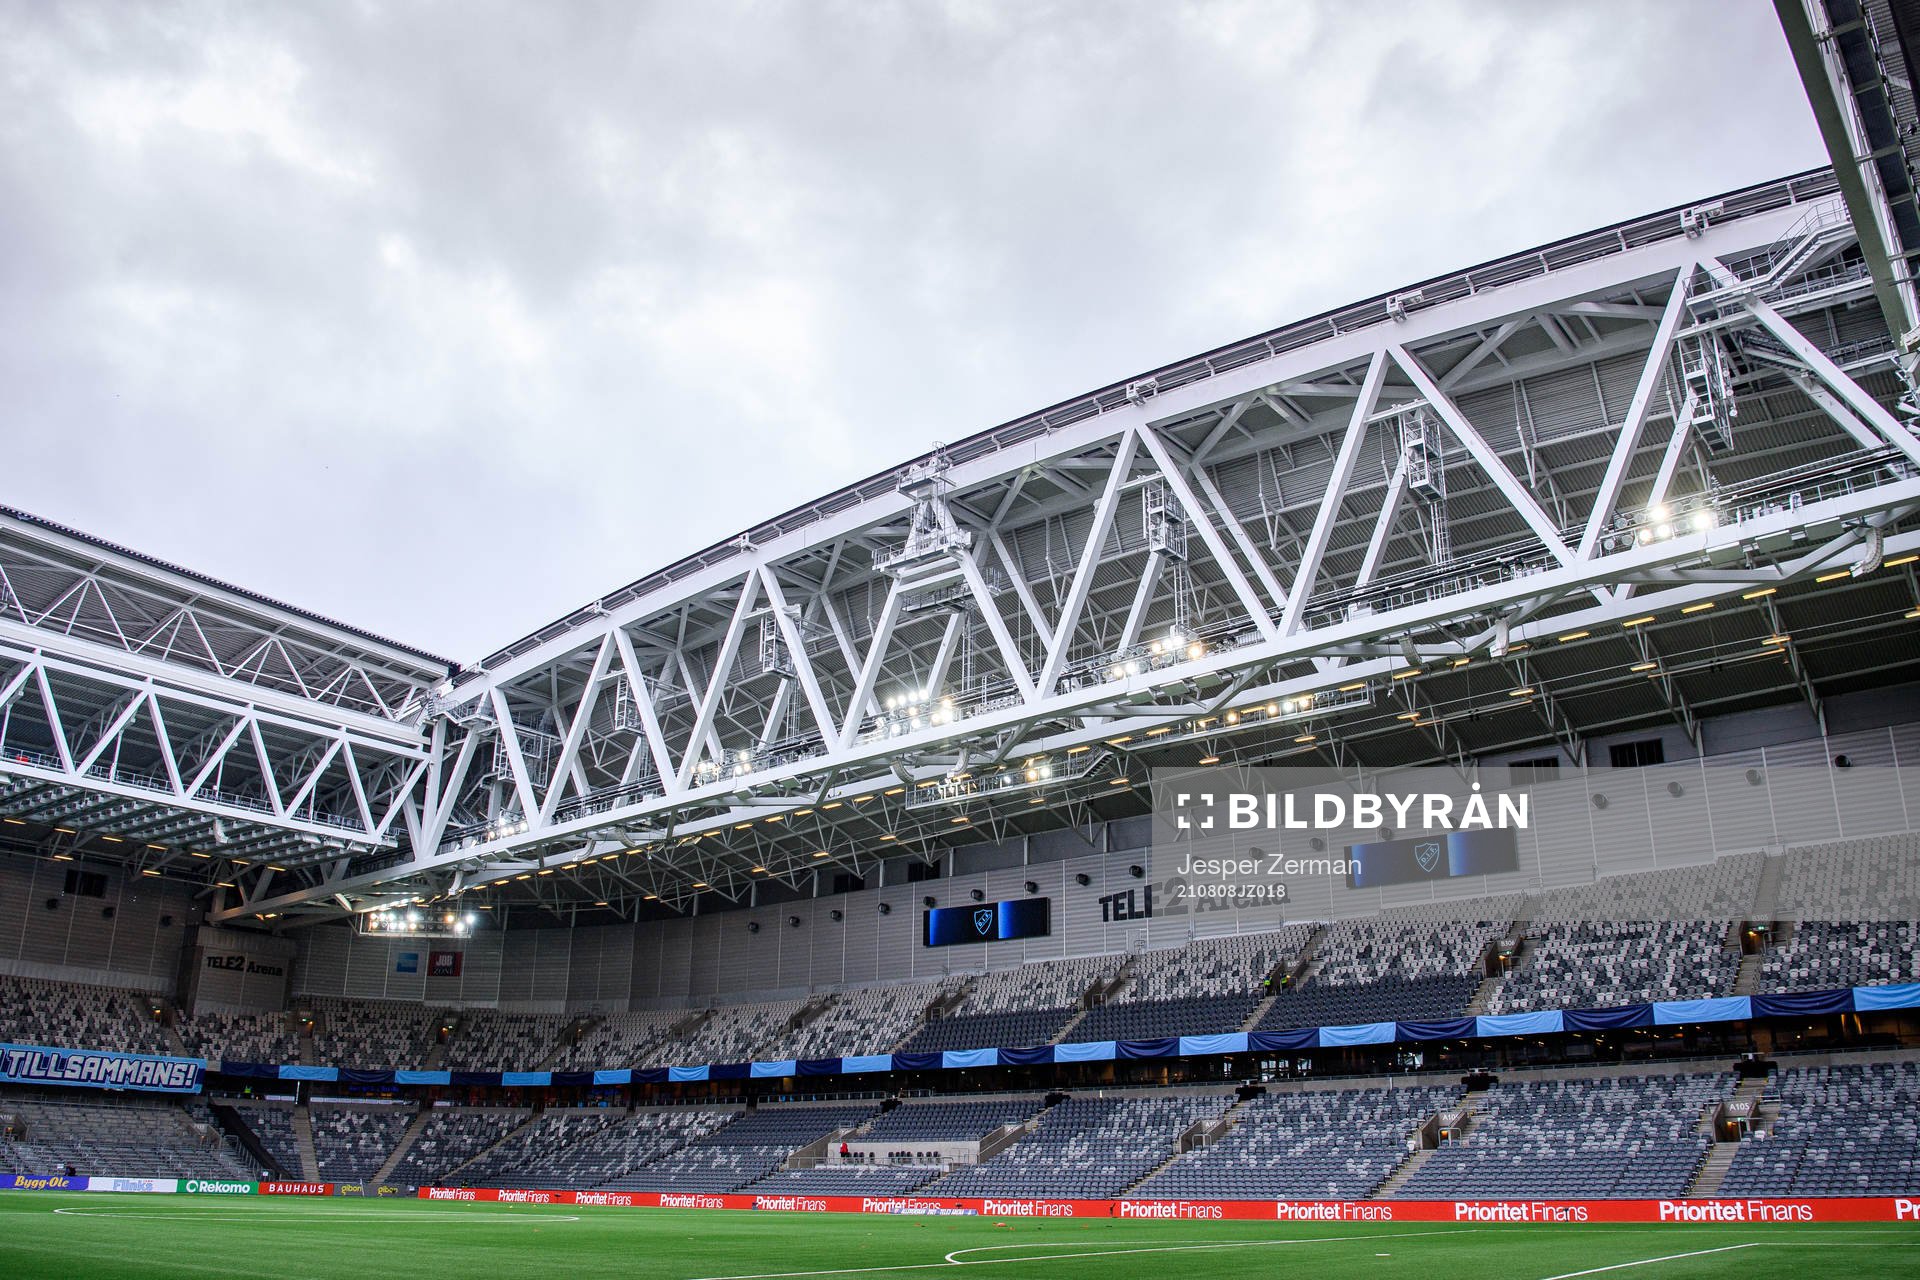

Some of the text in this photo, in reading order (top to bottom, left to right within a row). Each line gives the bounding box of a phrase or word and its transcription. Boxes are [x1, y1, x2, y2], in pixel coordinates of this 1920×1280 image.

[1098, 876, 1189, 923] TELE2
[207, 955, 283, 976] TELE2 Arena
[8, 1050, 198, 1087] TILLSAMMANS!
[1730, 1102, 1750, 1111] A105
[199, 1181, 250, 1193] Rekomo
[268, 1183, 324, 1193] BAUHAUS
[429, 1187, 475, 1201] Prioritet Finans
[498, 1190, 549, 1203] Prioritet Finans
[576, 1191, 631, 1206] Prioritet Finans
[660, 1194, 723, 1208] Prioritet Finans
[757, 1196, 826, 1211] Prioritet Finans
[862, 1198, 906, 1213] Prioritet
[983, 1199, 1034, 1216] Prioritet
[1035, 1201, 1073, 1216] Finans
[1120, 1201, 1222, 1219] Prioritet Finans
[1277, 1202, 1392, 1220] Prioritet Finans
[1455, 1202, 1588, 1221] Prioritet Finans
[1659, 1200, 1813, 1221] Prioritet Finans
